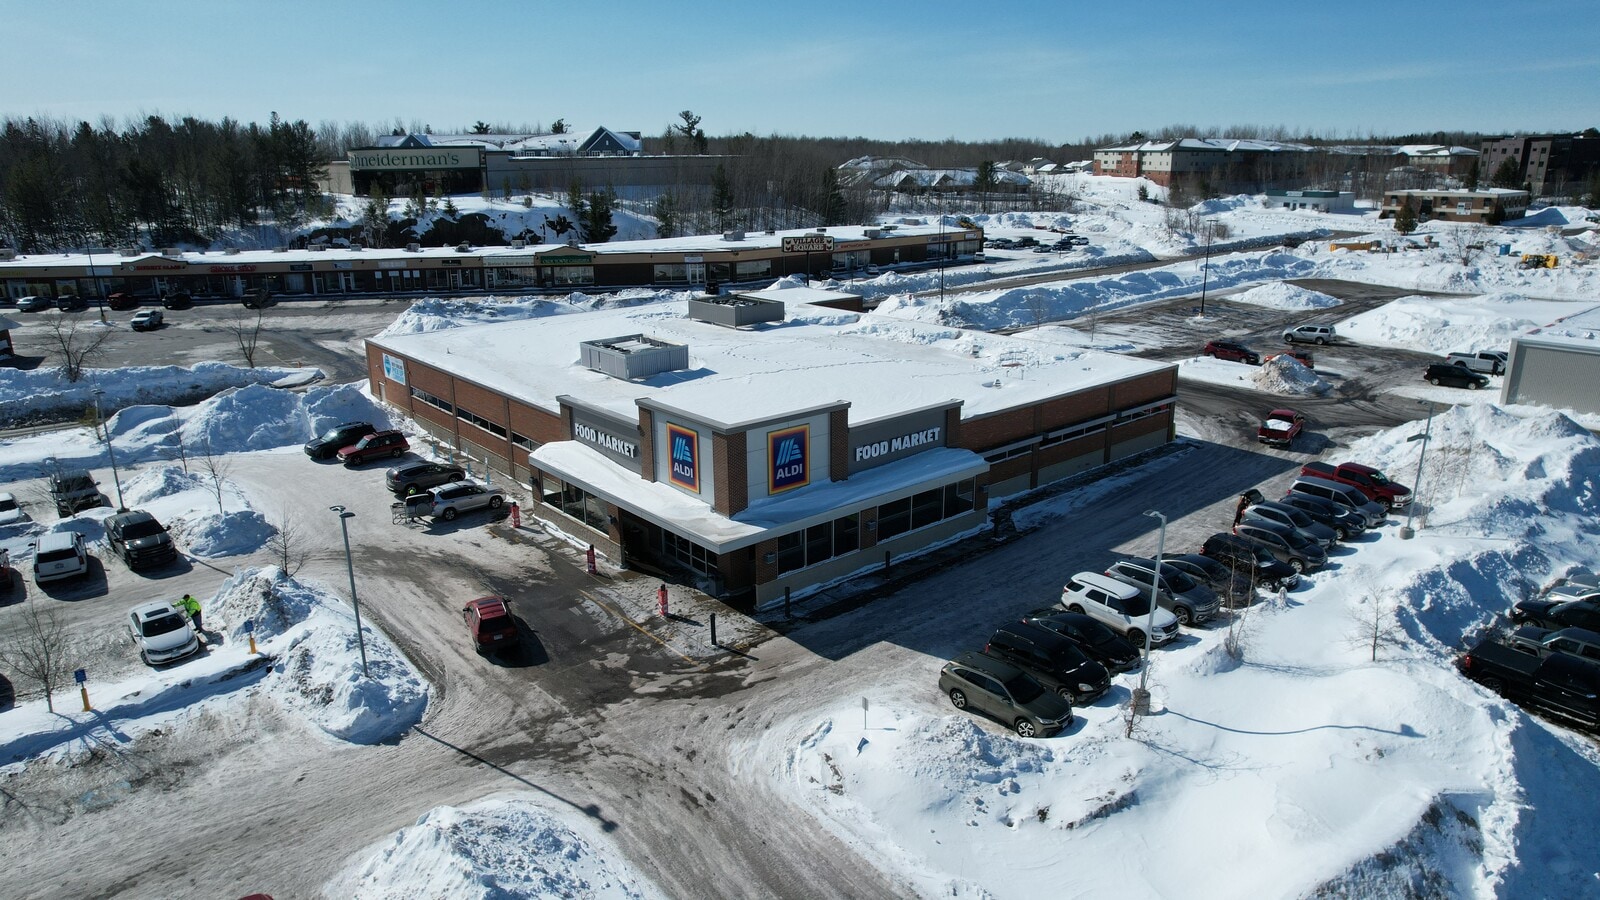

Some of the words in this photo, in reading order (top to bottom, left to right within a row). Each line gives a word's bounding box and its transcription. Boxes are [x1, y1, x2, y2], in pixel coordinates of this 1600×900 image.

[574, 423, 597, 442] FOOD
[597, 431, 635, 458] MARKET
[855, 441, 889, 462] FOOD
[891, 427, 941, 452] MARKET
[673, 461, 694, 479] ALDI
[776, 463, 803, 480] ALDI
